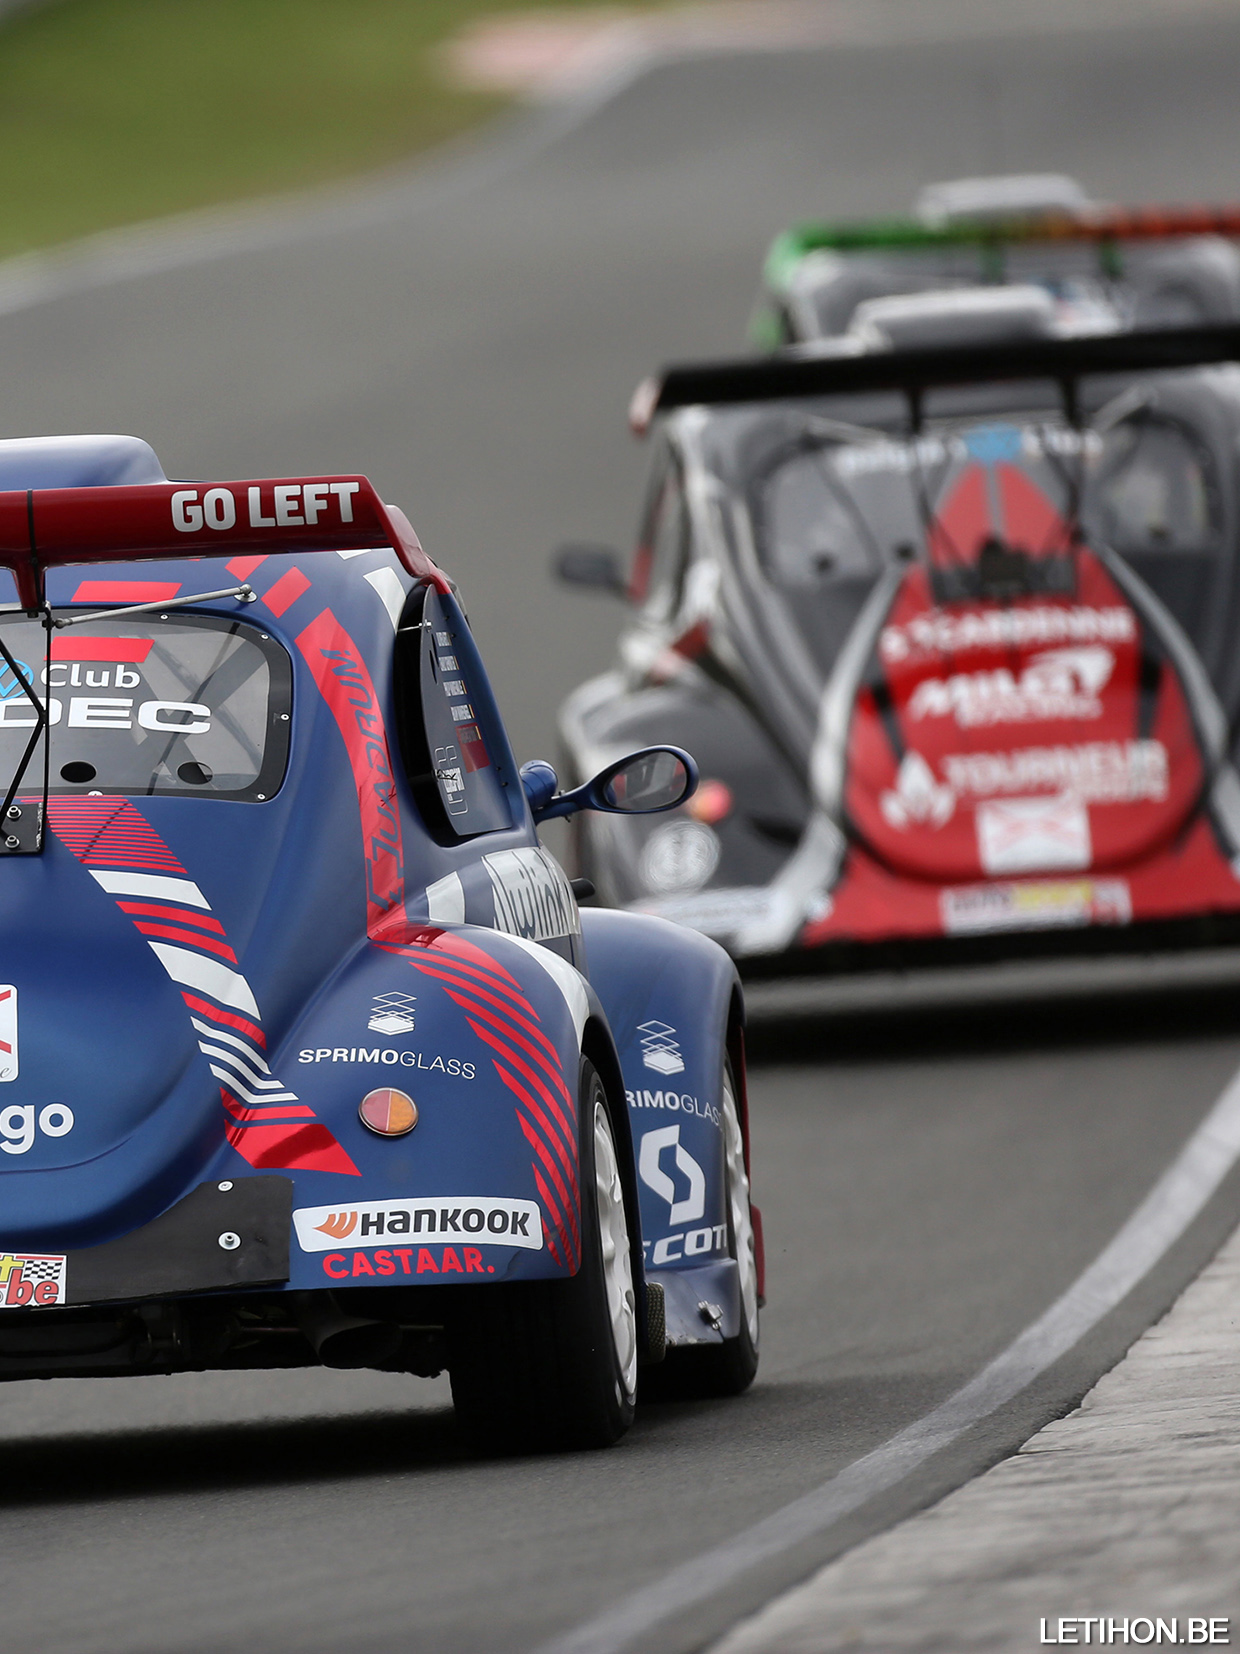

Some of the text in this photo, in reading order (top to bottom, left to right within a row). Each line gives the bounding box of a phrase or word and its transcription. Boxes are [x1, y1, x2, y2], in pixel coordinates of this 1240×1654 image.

[171, 482, 360, 532] GO LEFT
[39, 663, 141, 690] Club
[298, 1047, 477, 1080] SPRIMOGLASS
[625, 1090, 724, 1134] RIMOGLAS
[361, 1207, 530, 1238] HANKOOK
[322, 1246, 495, 1280] CASTAAR.
[5, 1269, 59, 1305] be
